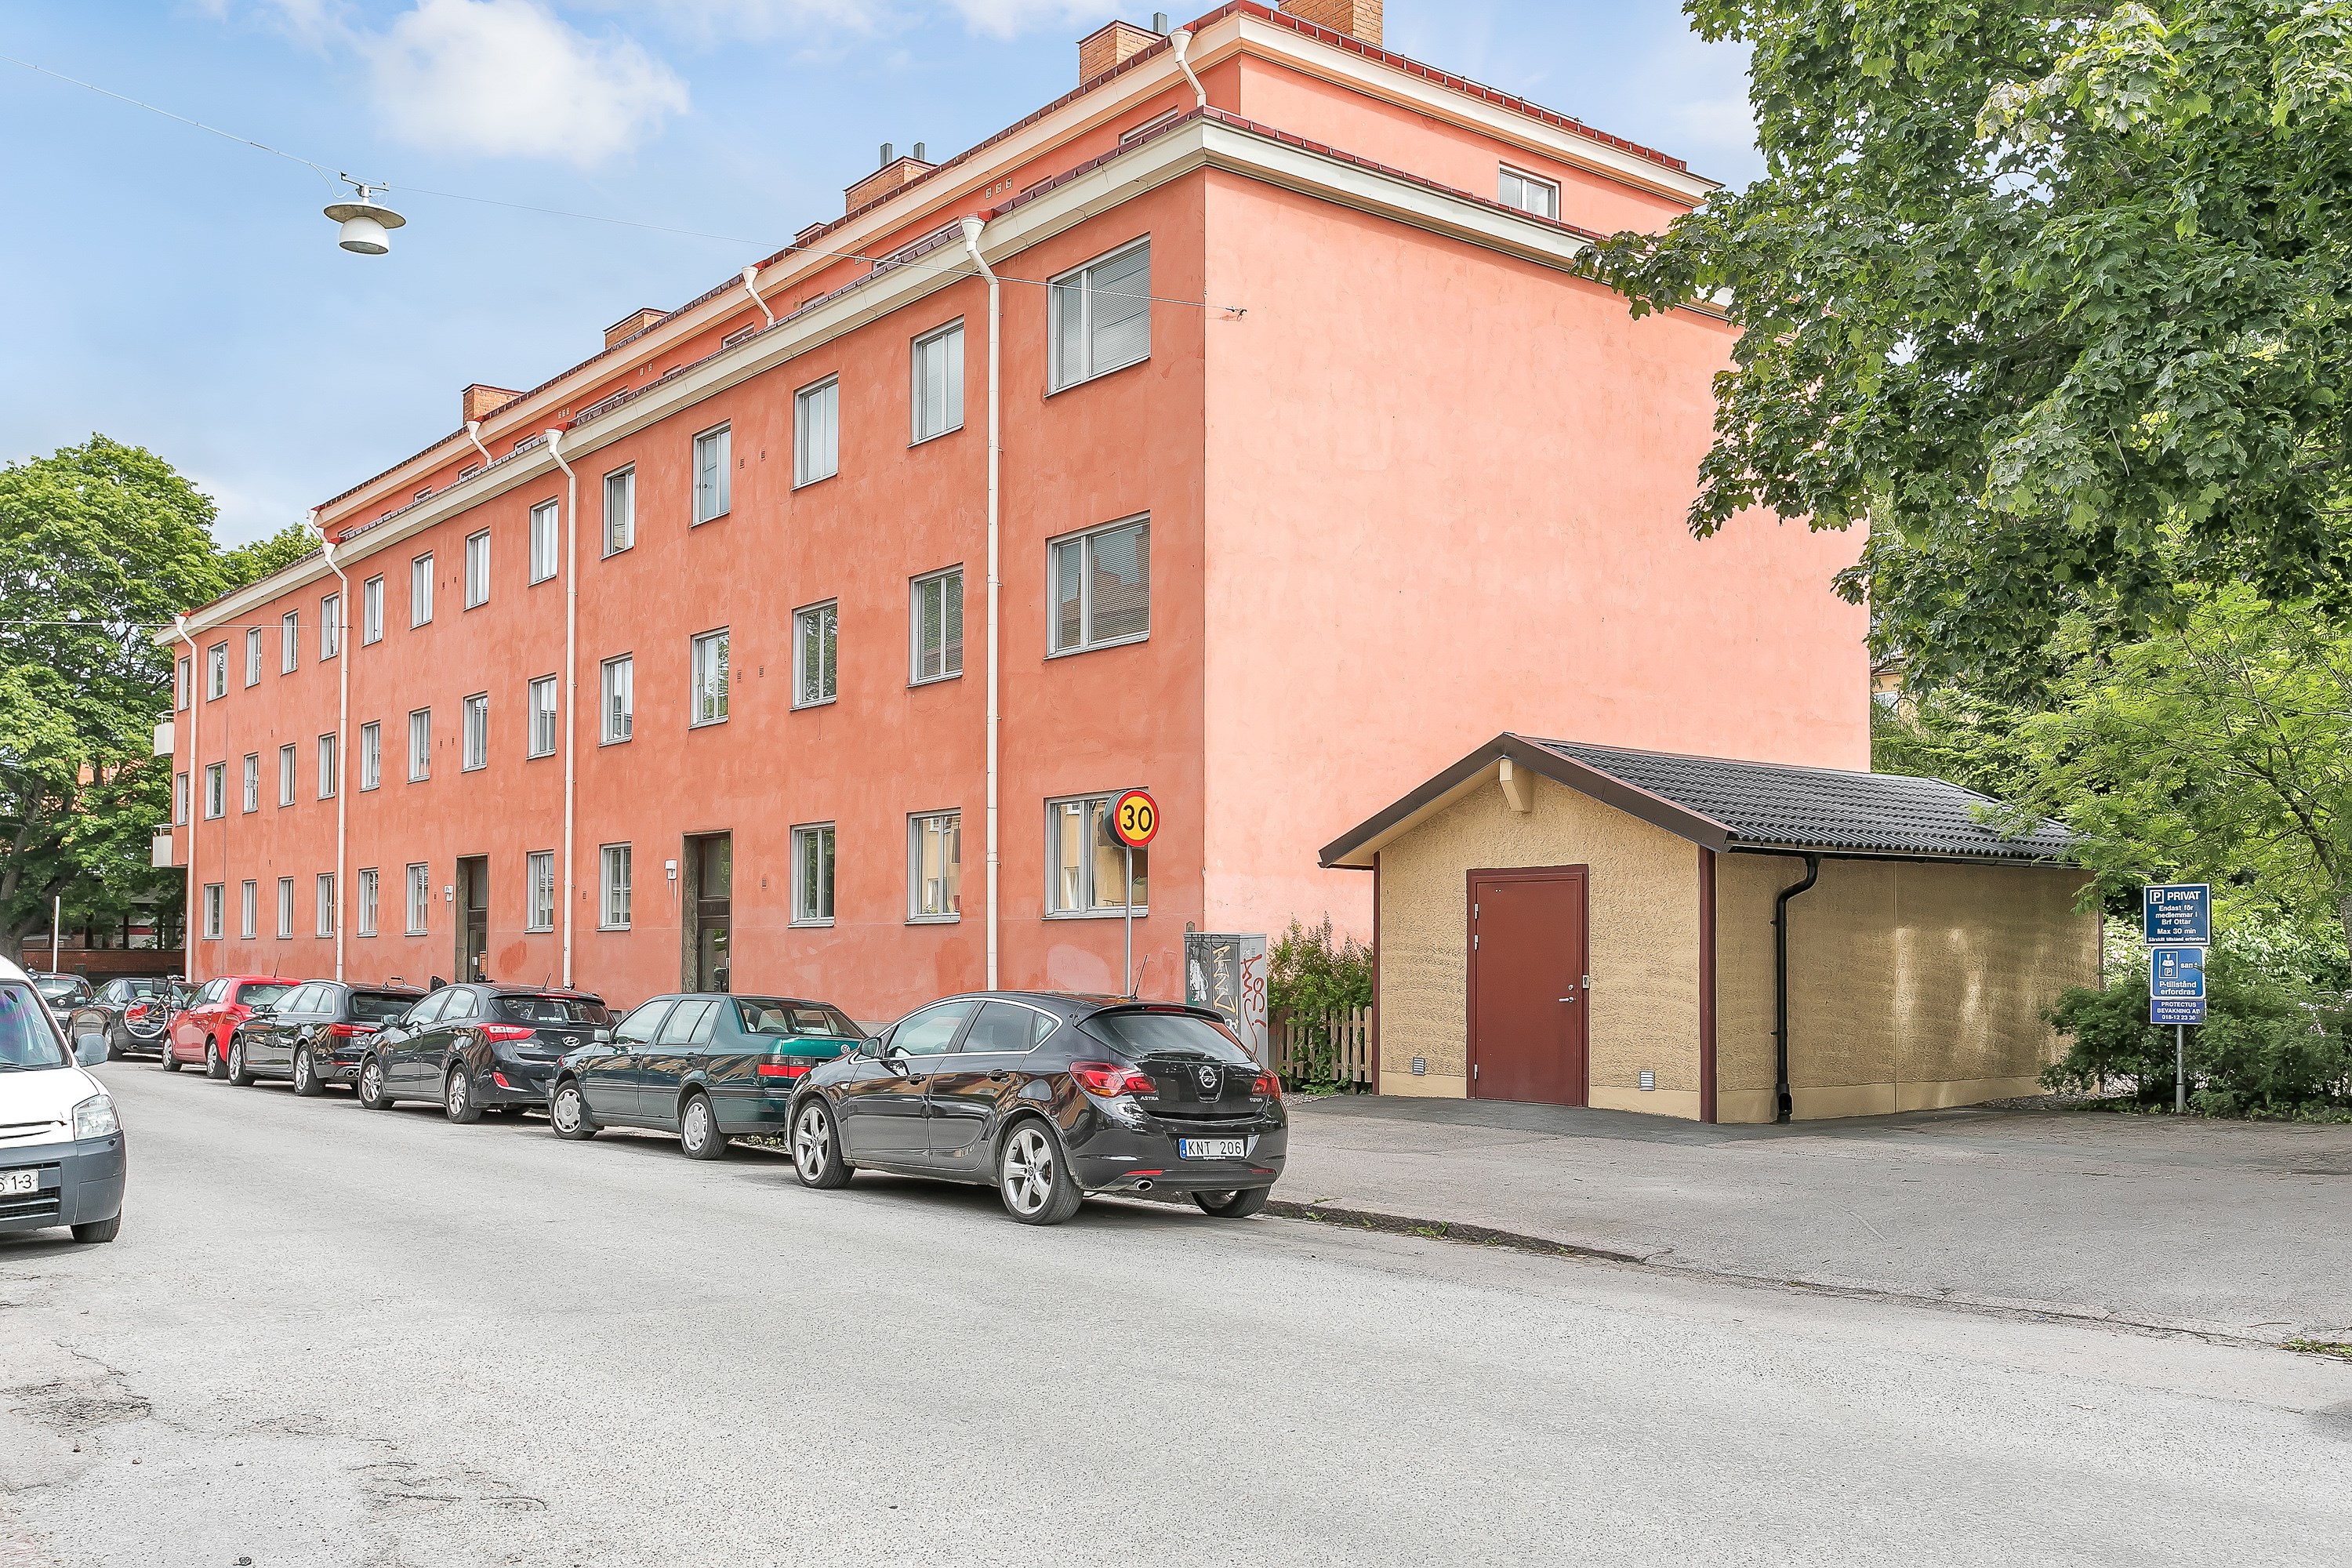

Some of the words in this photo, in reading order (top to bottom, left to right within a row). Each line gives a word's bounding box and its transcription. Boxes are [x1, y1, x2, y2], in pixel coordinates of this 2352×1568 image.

[1123, 804, 1152, 832] 30
[2167, 891, 2201, 901] PRIVAT
[1188, 1141, 1210, 1155] KNT
[1219, 1141, 1242, 1155] 206
